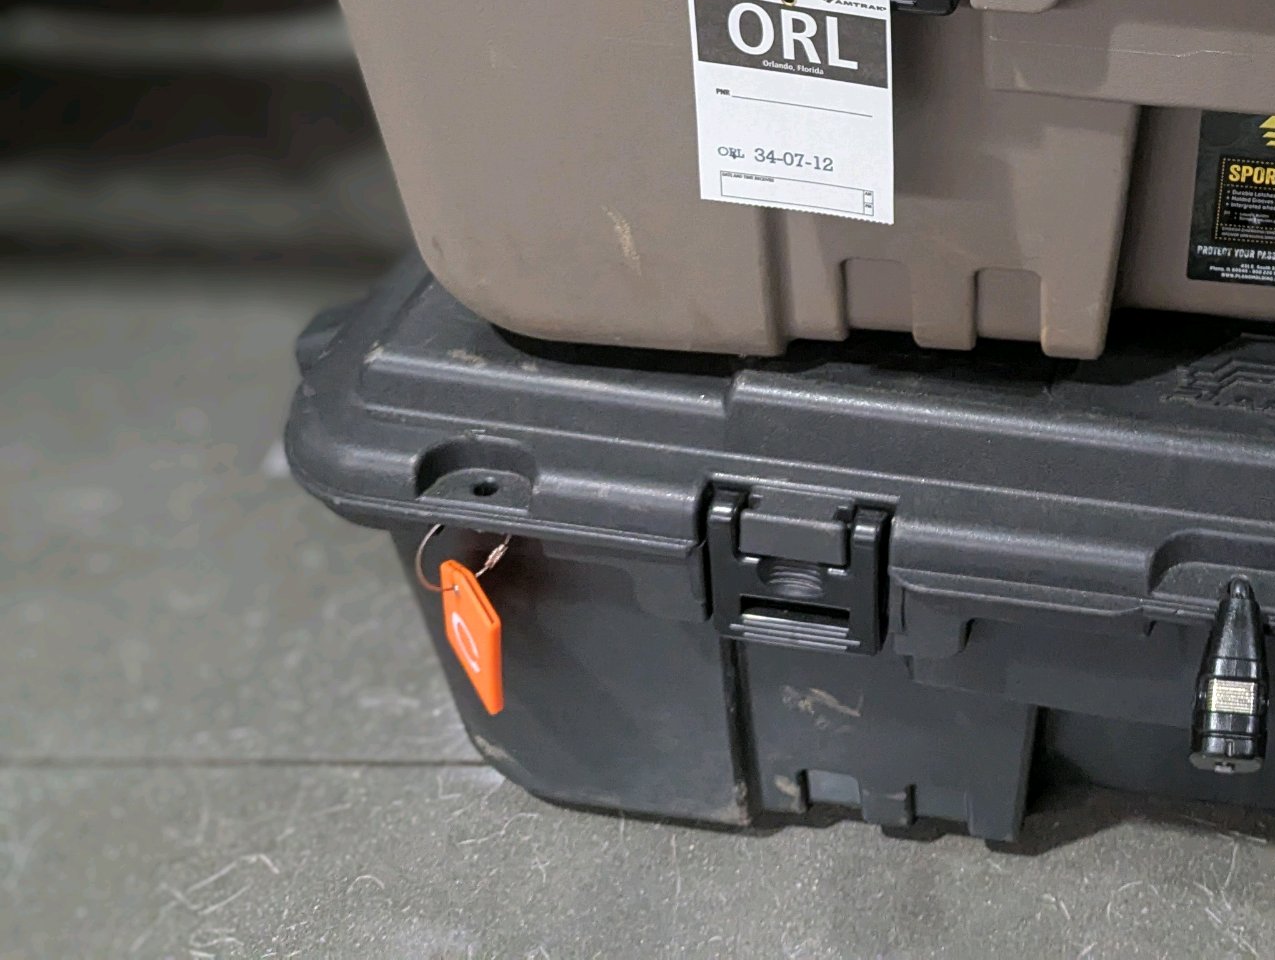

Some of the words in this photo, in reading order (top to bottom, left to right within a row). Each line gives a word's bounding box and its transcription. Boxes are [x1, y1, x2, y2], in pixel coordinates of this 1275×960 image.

[833, 0, 885, 11] AMTRAK
[728, 2, 858, 70] ORL
[762, 59, 796, 72] Orlando,
[797, 64, 825, 75] Florida
[717, 146, 745, 159] ORL
[754, 147, 834, 172] 34-07-12
[1196, 245, 1232, 256] PROTECT
[1234, 248, 1255, 259] YOUR
